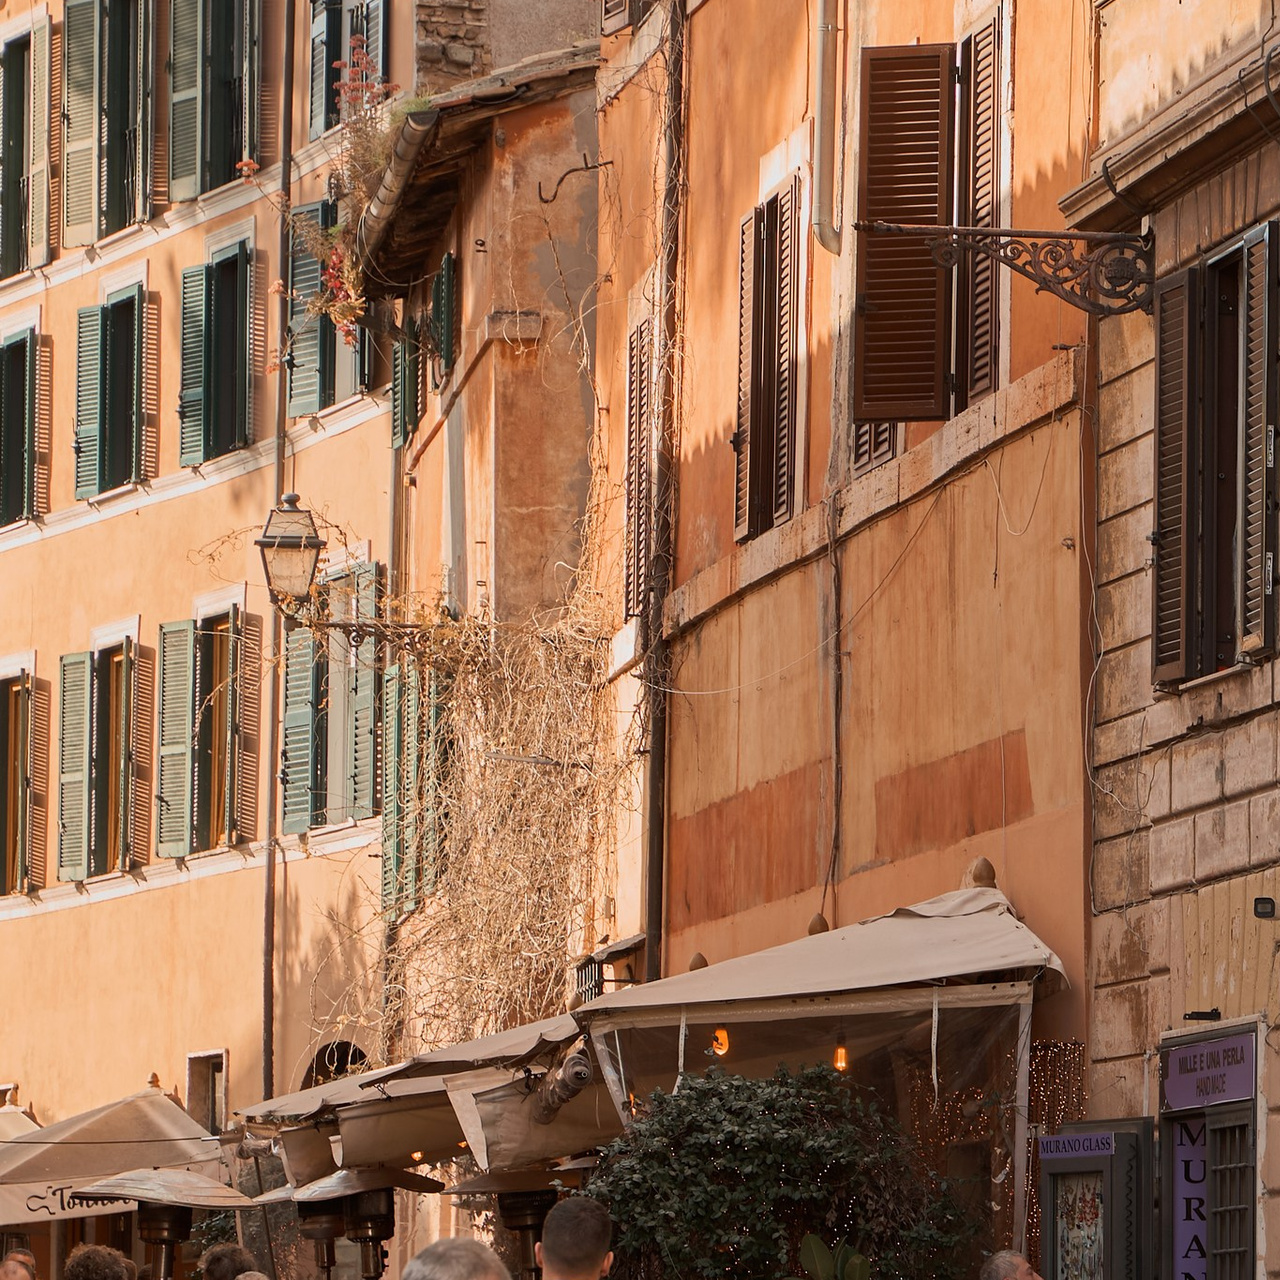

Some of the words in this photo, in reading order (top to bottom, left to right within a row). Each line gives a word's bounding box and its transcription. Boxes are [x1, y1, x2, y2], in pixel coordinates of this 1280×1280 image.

[1179, 1054, 1198, 1075] MILLE
[1199, 1052, 1205, 1071] E
[1206, 1049, 1221, 1070] UNA
[1222, 1045, 1245, 1067] PERLA
[1041, 1139, 1081, 1154] MURANO
[1082, 1136, 1111, 1152] GLASS
